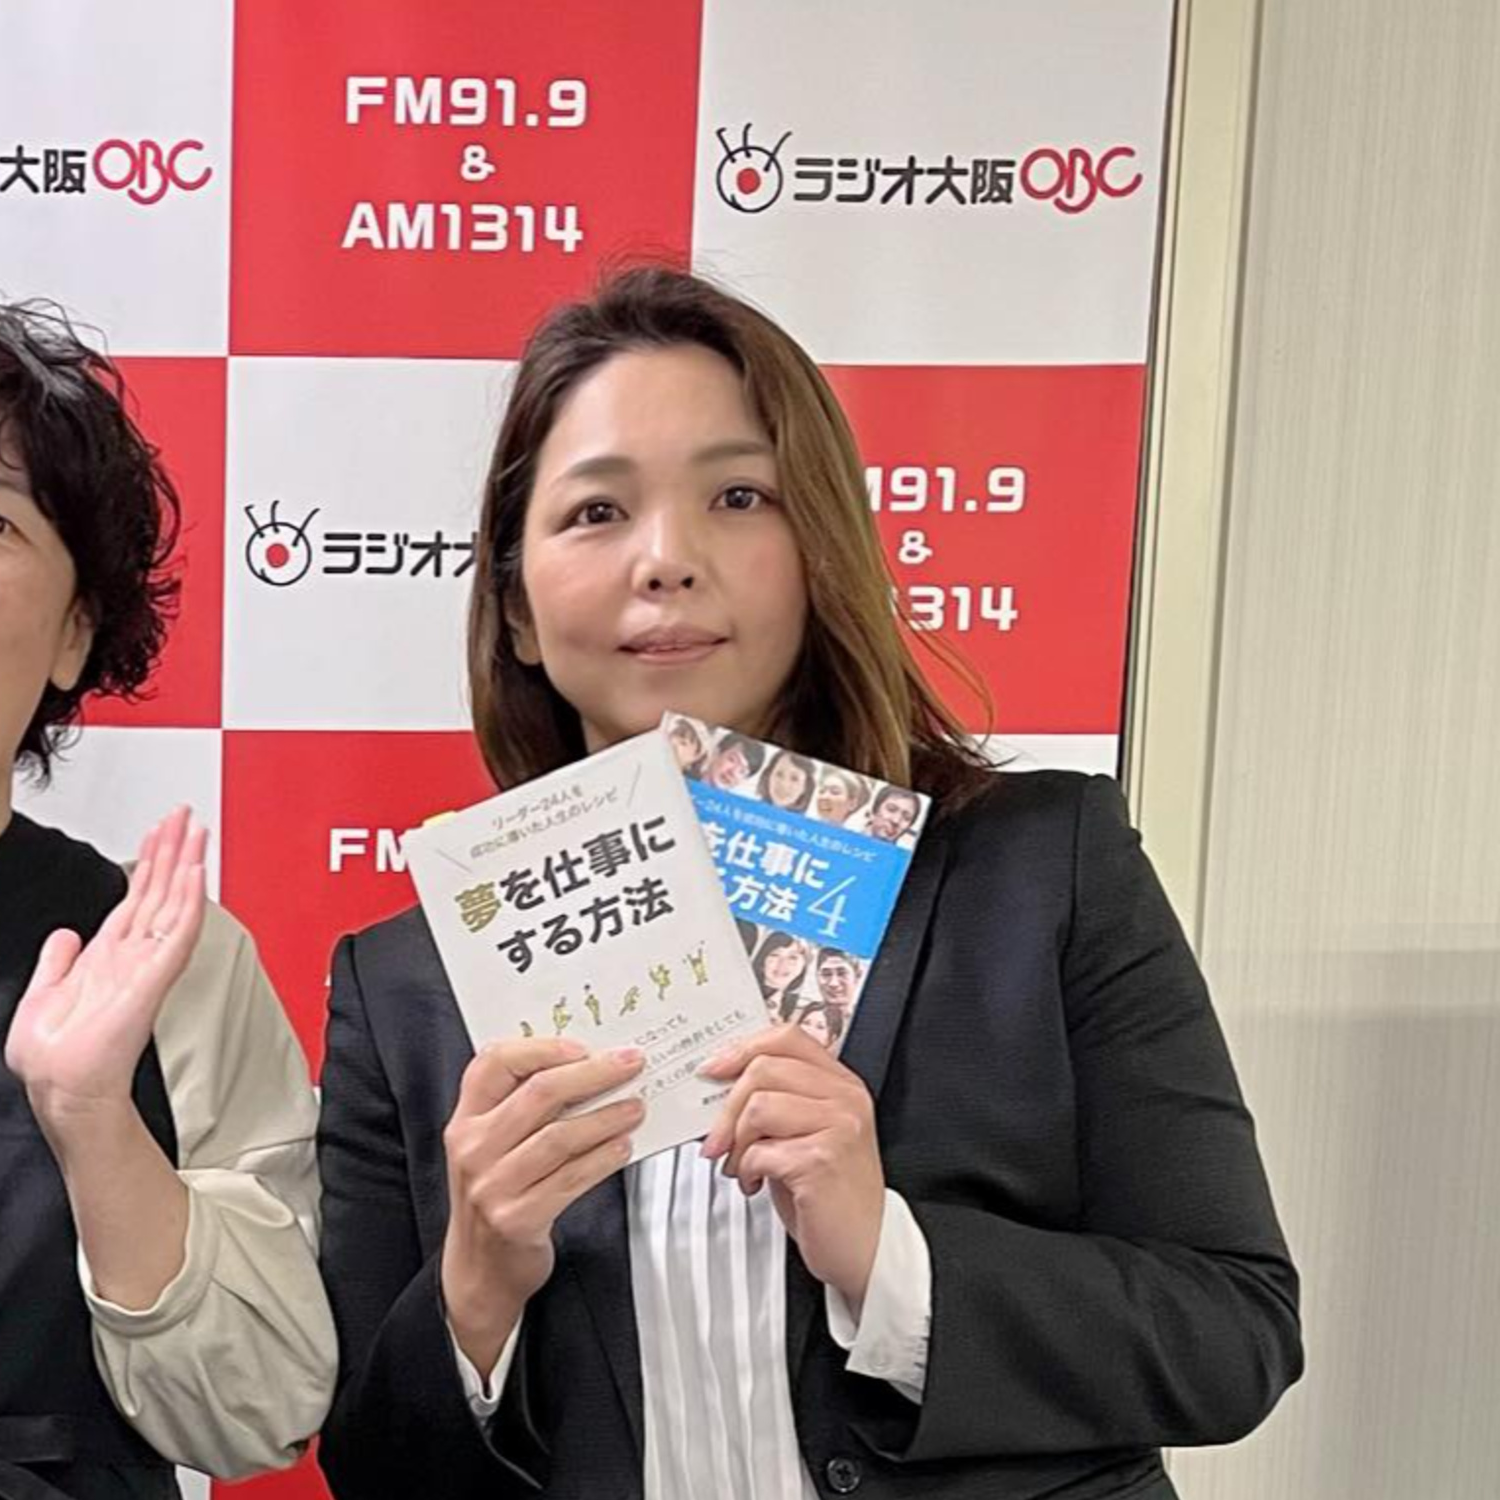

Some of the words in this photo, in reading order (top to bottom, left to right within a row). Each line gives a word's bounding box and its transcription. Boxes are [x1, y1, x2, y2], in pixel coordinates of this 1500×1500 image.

[344, 76, 587, 128] FM91.9
[460, 145, 495, 181] &
[792, 158, 1015, 206] ラジオ大阪
[341, 203, 584, 252] AM1314
[898, 530, 933, 565] &
[888, 586, 1019, 632] 314
[454, 814, 677, 933] 夢を仕事に
[714, 867, 799, 922] 方法
[497, 874, 674, 973] する方法
